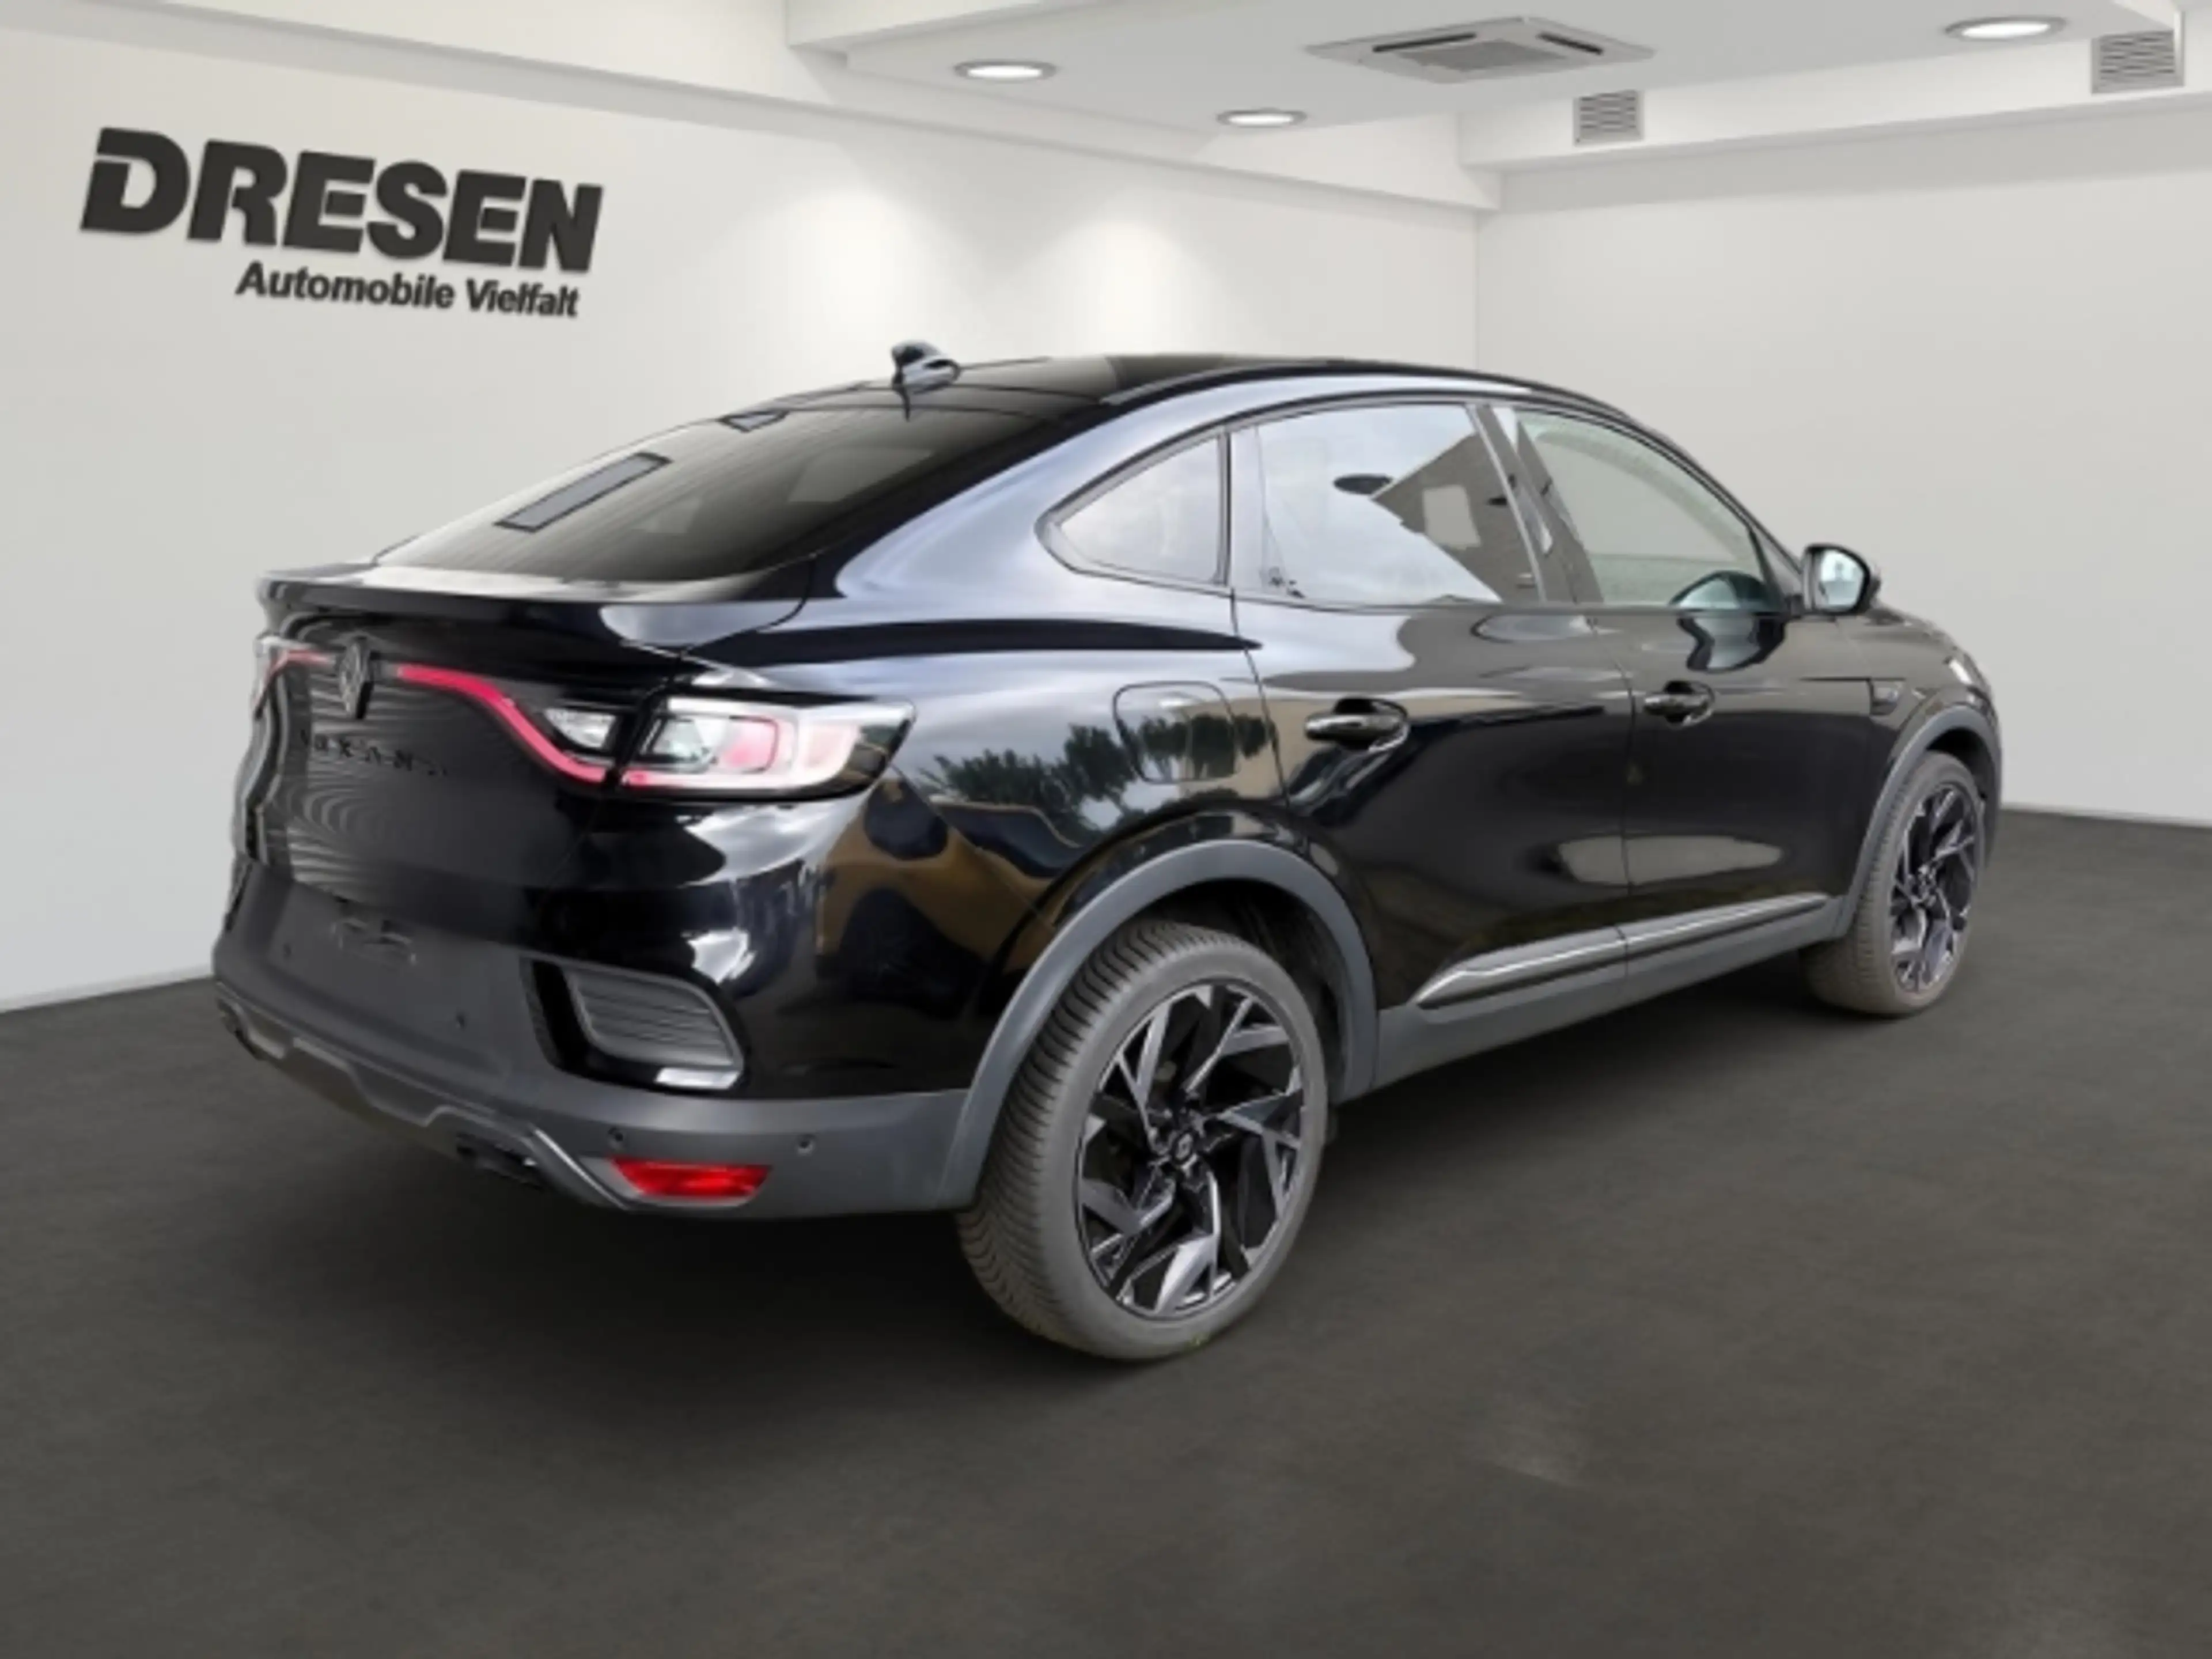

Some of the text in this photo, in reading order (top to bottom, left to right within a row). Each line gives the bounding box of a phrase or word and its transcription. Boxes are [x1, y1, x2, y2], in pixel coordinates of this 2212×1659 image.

[81, 127, 603, 273] DRESEN
[236, 262, 578, 316] Automobile Vielfalt
